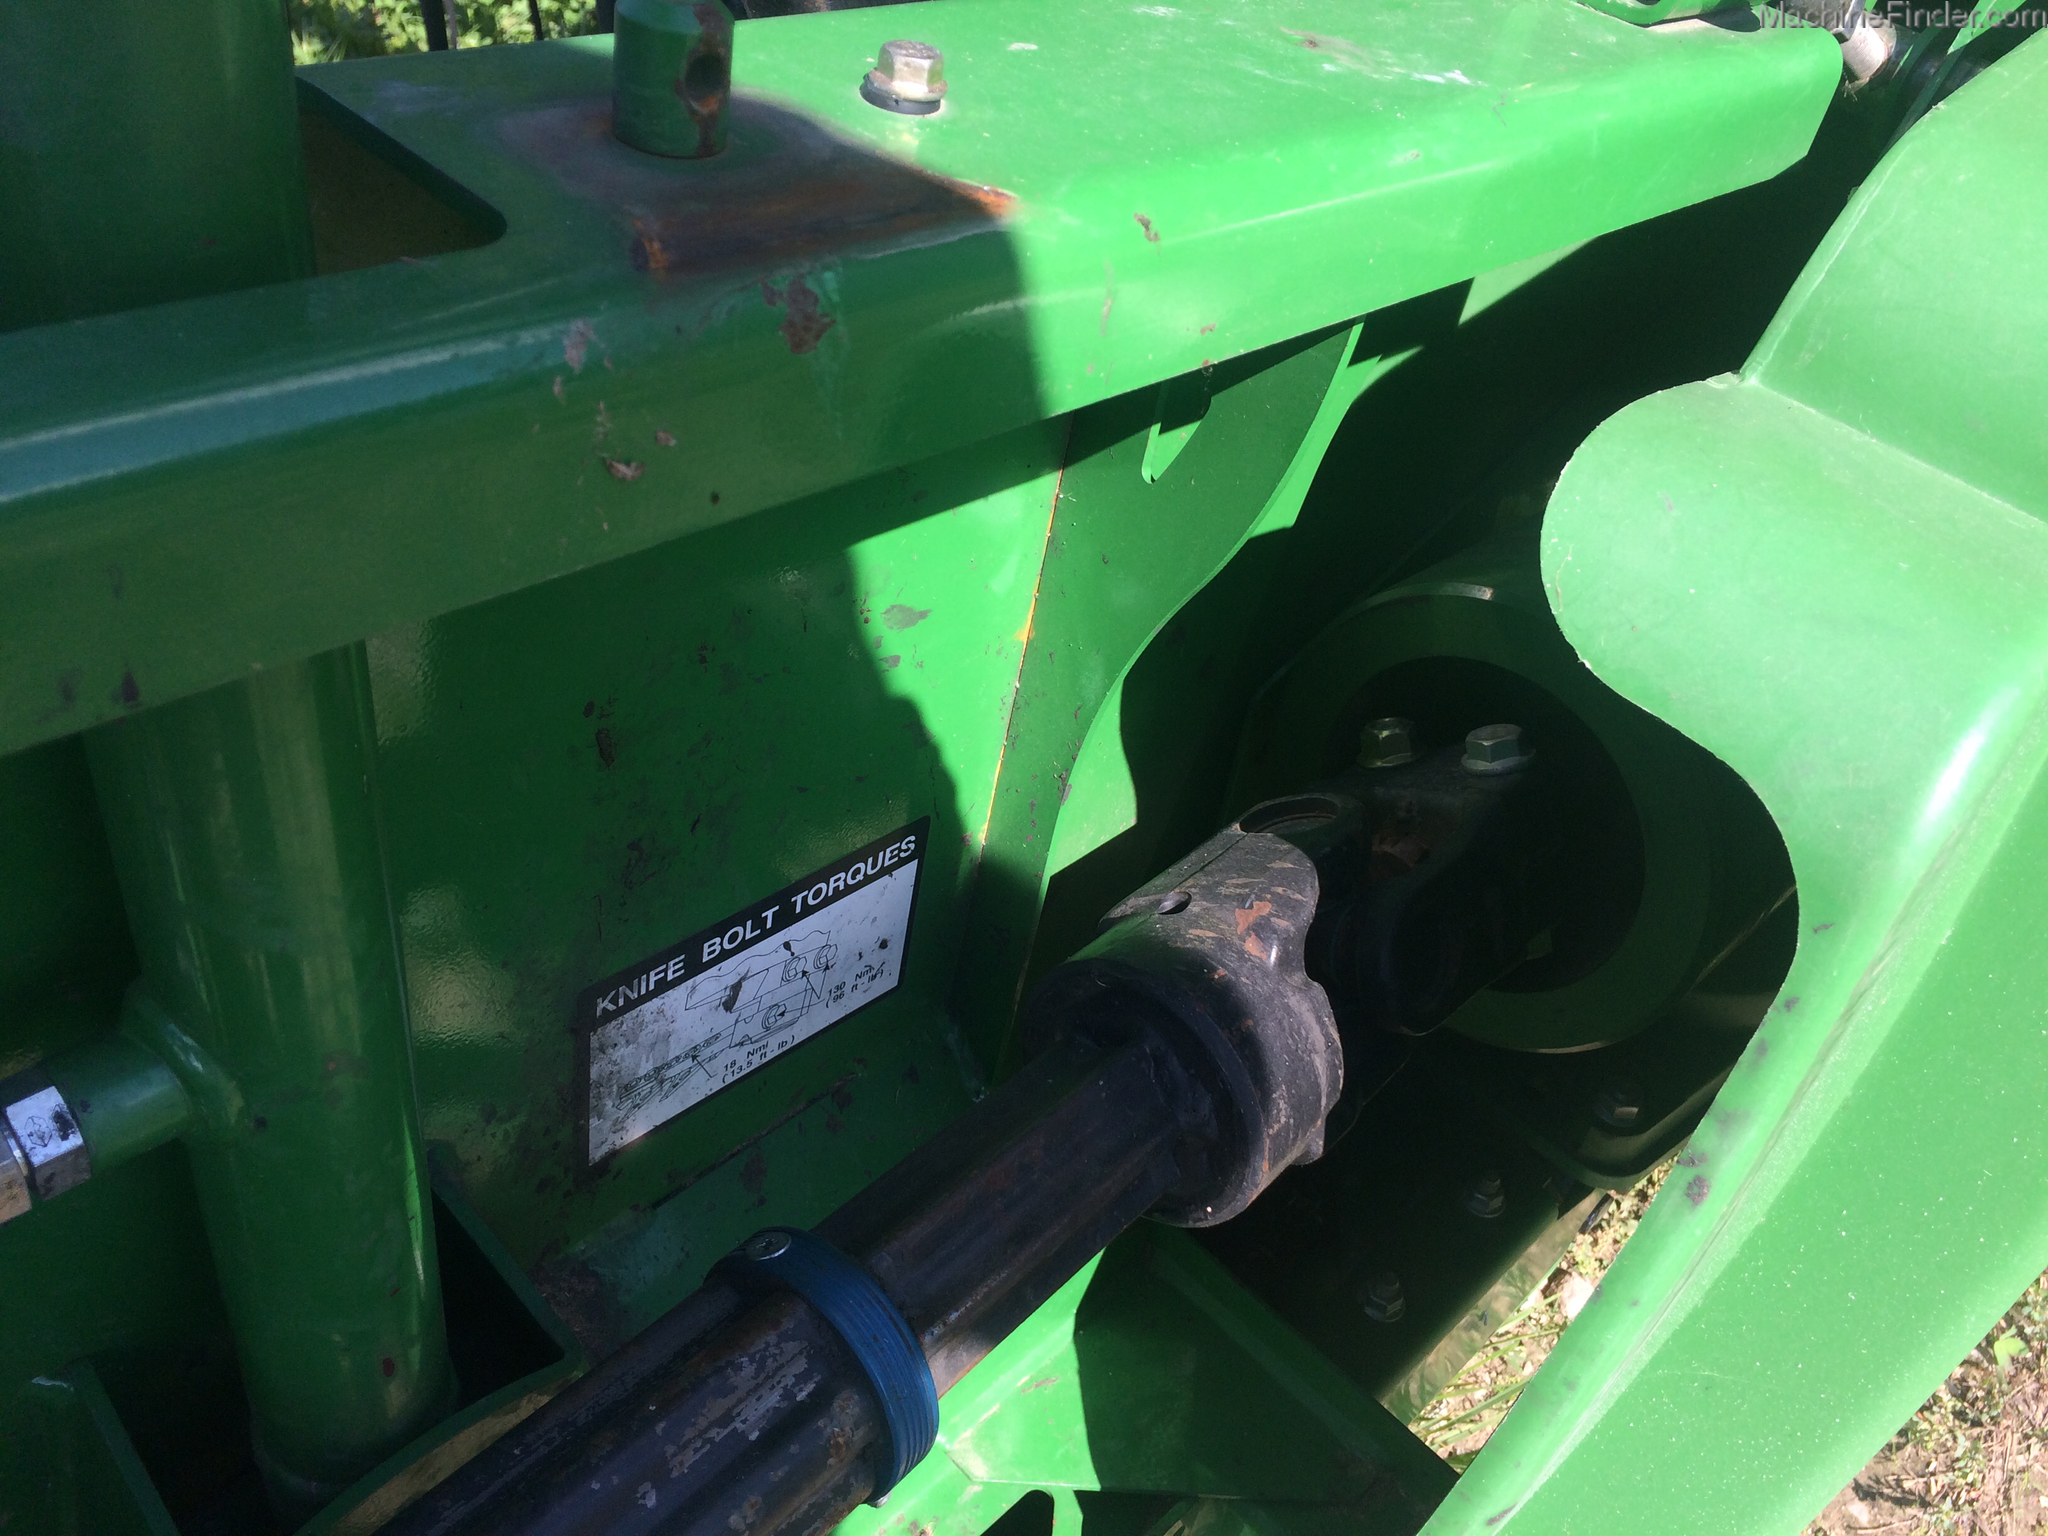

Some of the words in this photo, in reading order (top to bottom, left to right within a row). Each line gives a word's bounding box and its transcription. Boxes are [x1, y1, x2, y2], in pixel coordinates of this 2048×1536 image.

[596, 953, 686, 1019] KNIFE
[702, 905, 779, 963] BOLT
[791, 835, 917, 915] TORQUES
[828, 981, 846, 996] 130
[724, 1059, 737, 1072] 18
